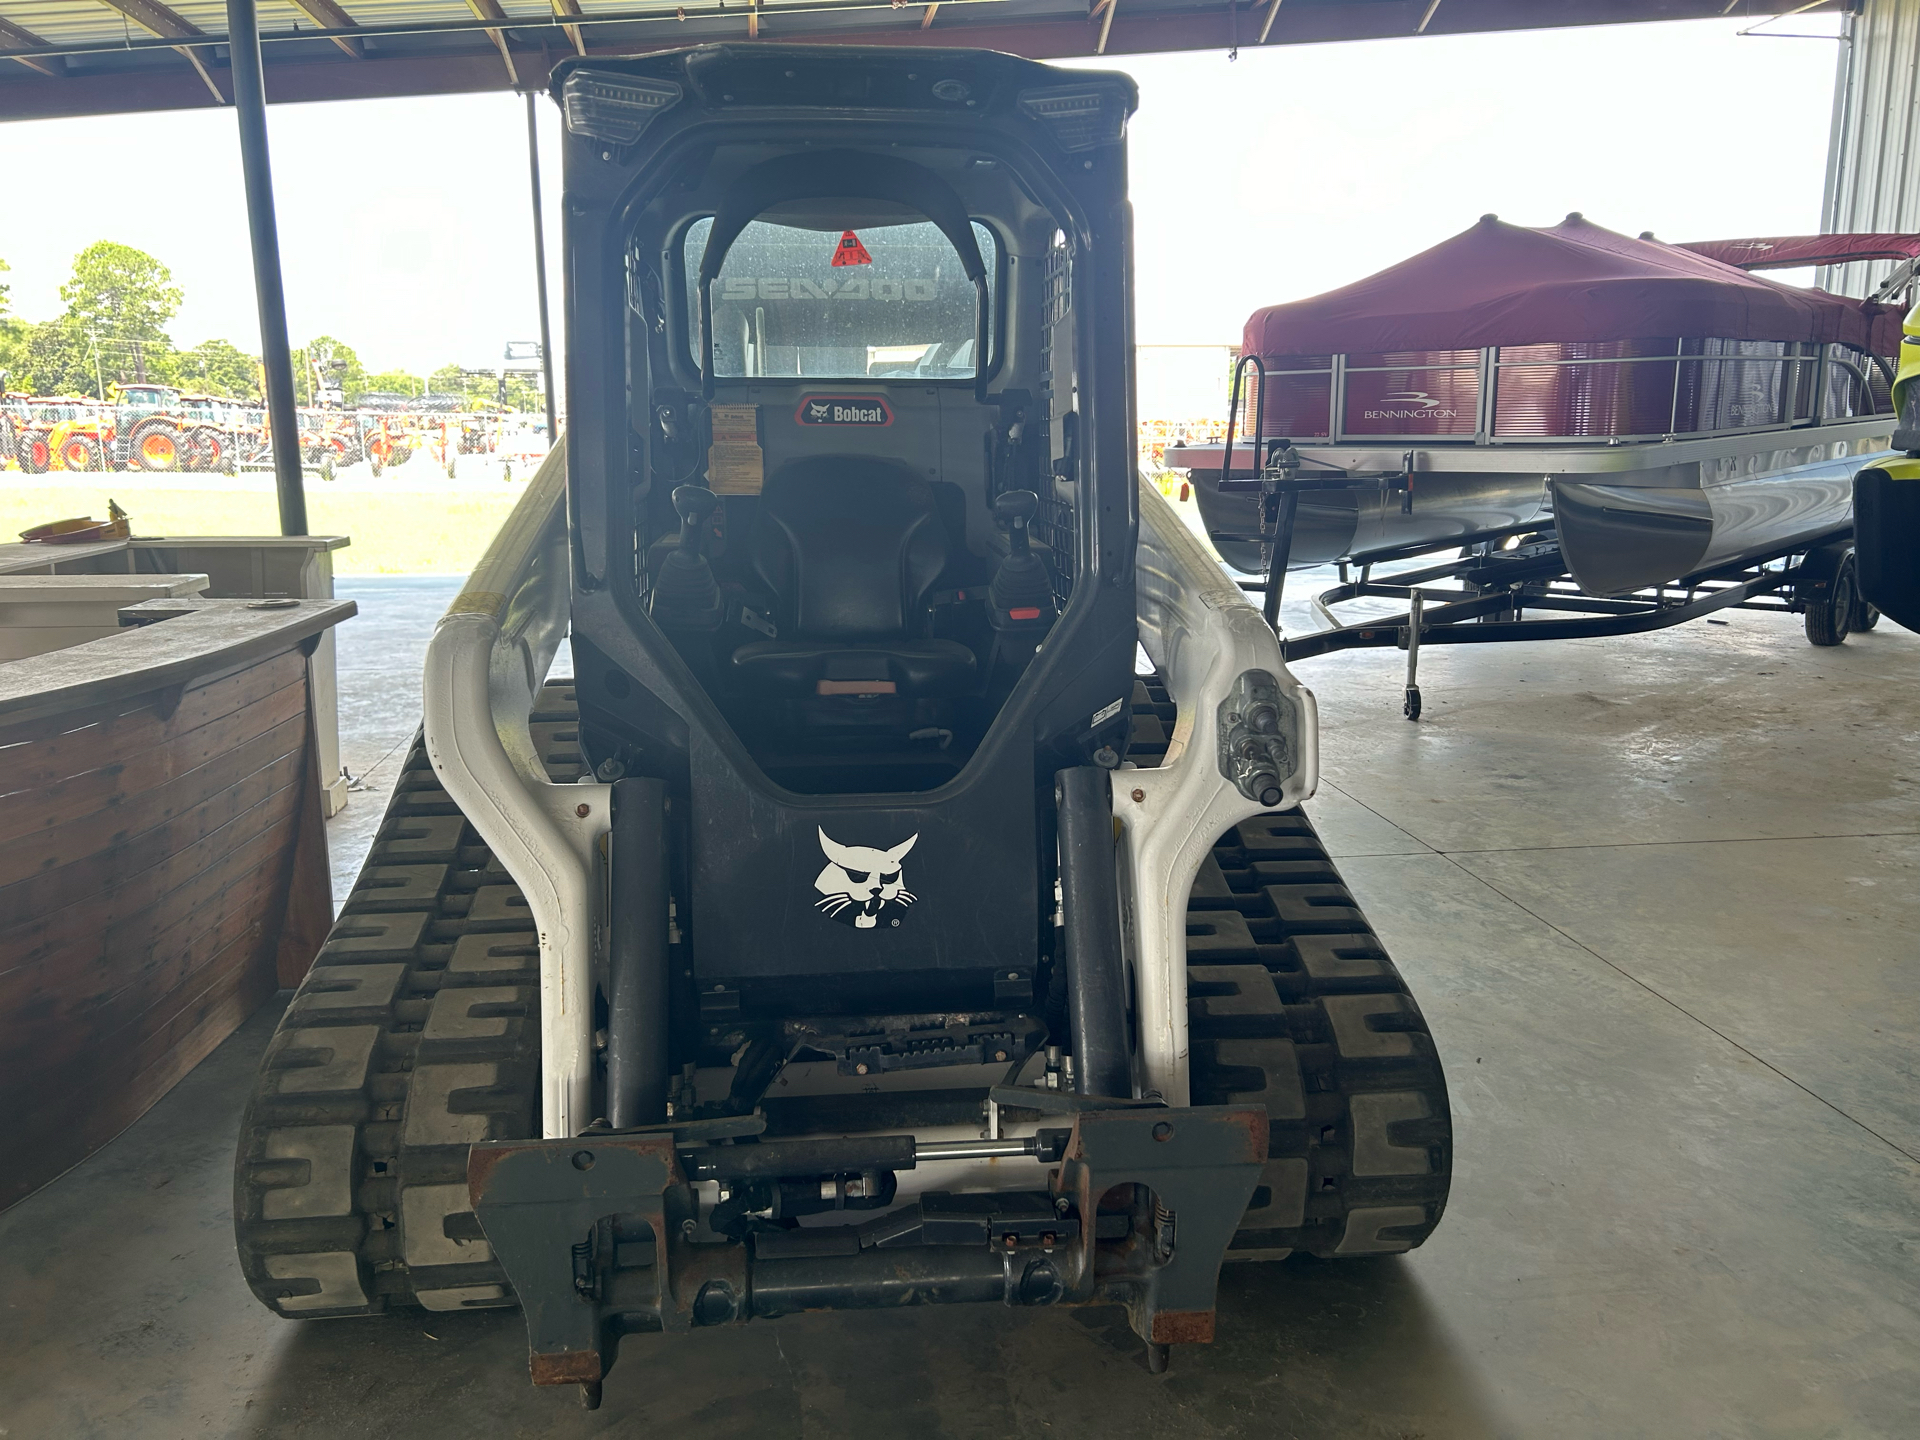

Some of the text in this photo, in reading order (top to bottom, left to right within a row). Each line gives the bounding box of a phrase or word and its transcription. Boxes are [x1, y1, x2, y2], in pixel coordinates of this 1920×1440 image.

[833, 406, 882, 422] Bobcat
[1364, 409, 1457, 419] BENNINGTON
[1730, 402, 1774, 416] BENGTON
